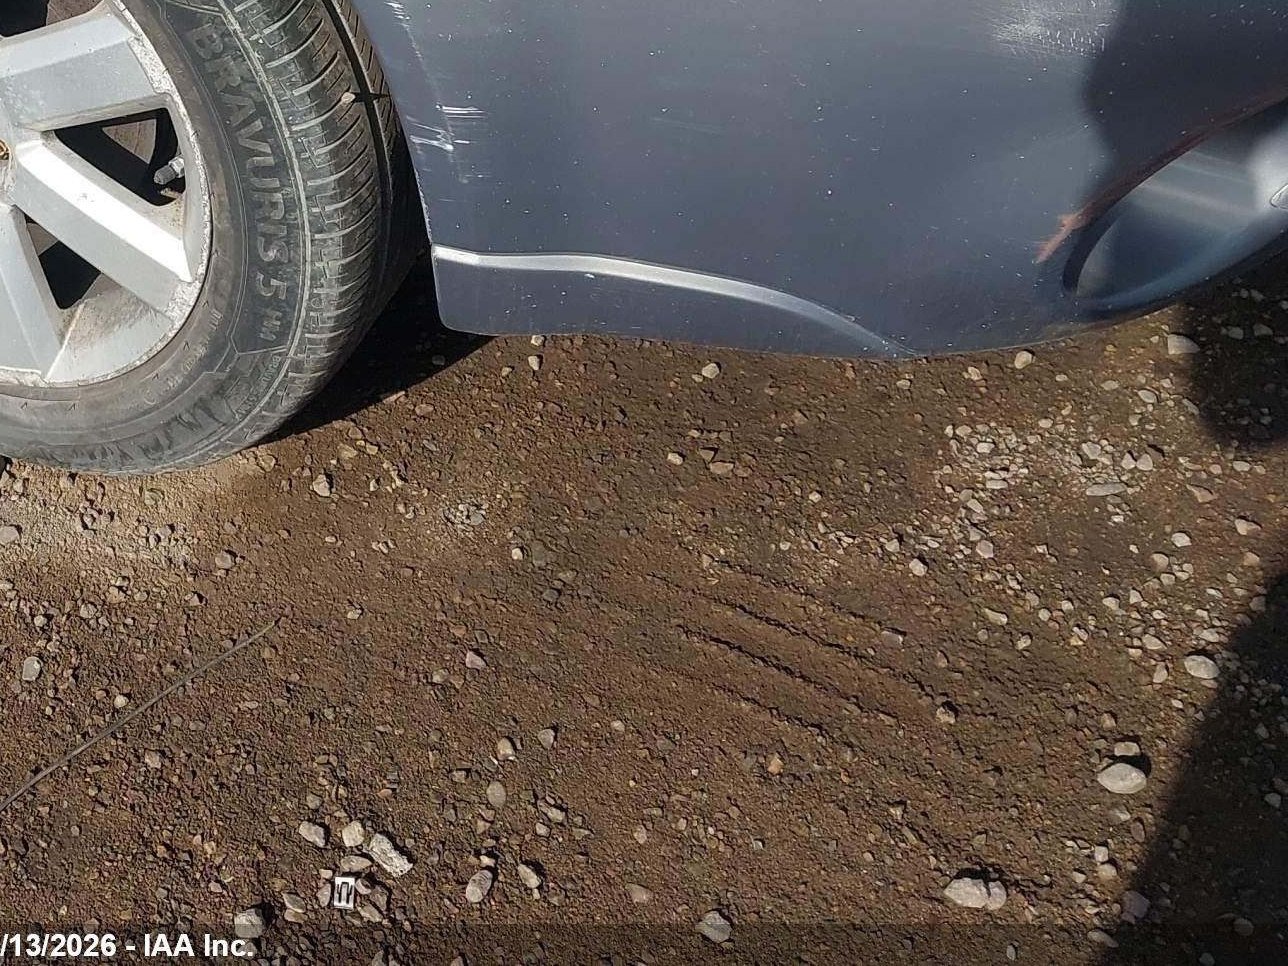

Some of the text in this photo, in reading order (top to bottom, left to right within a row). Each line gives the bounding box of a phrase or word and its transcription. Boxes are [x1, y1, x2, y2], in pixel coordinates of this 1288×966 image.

[186, 22, 289, 342] BRAVURIS 5 HM
